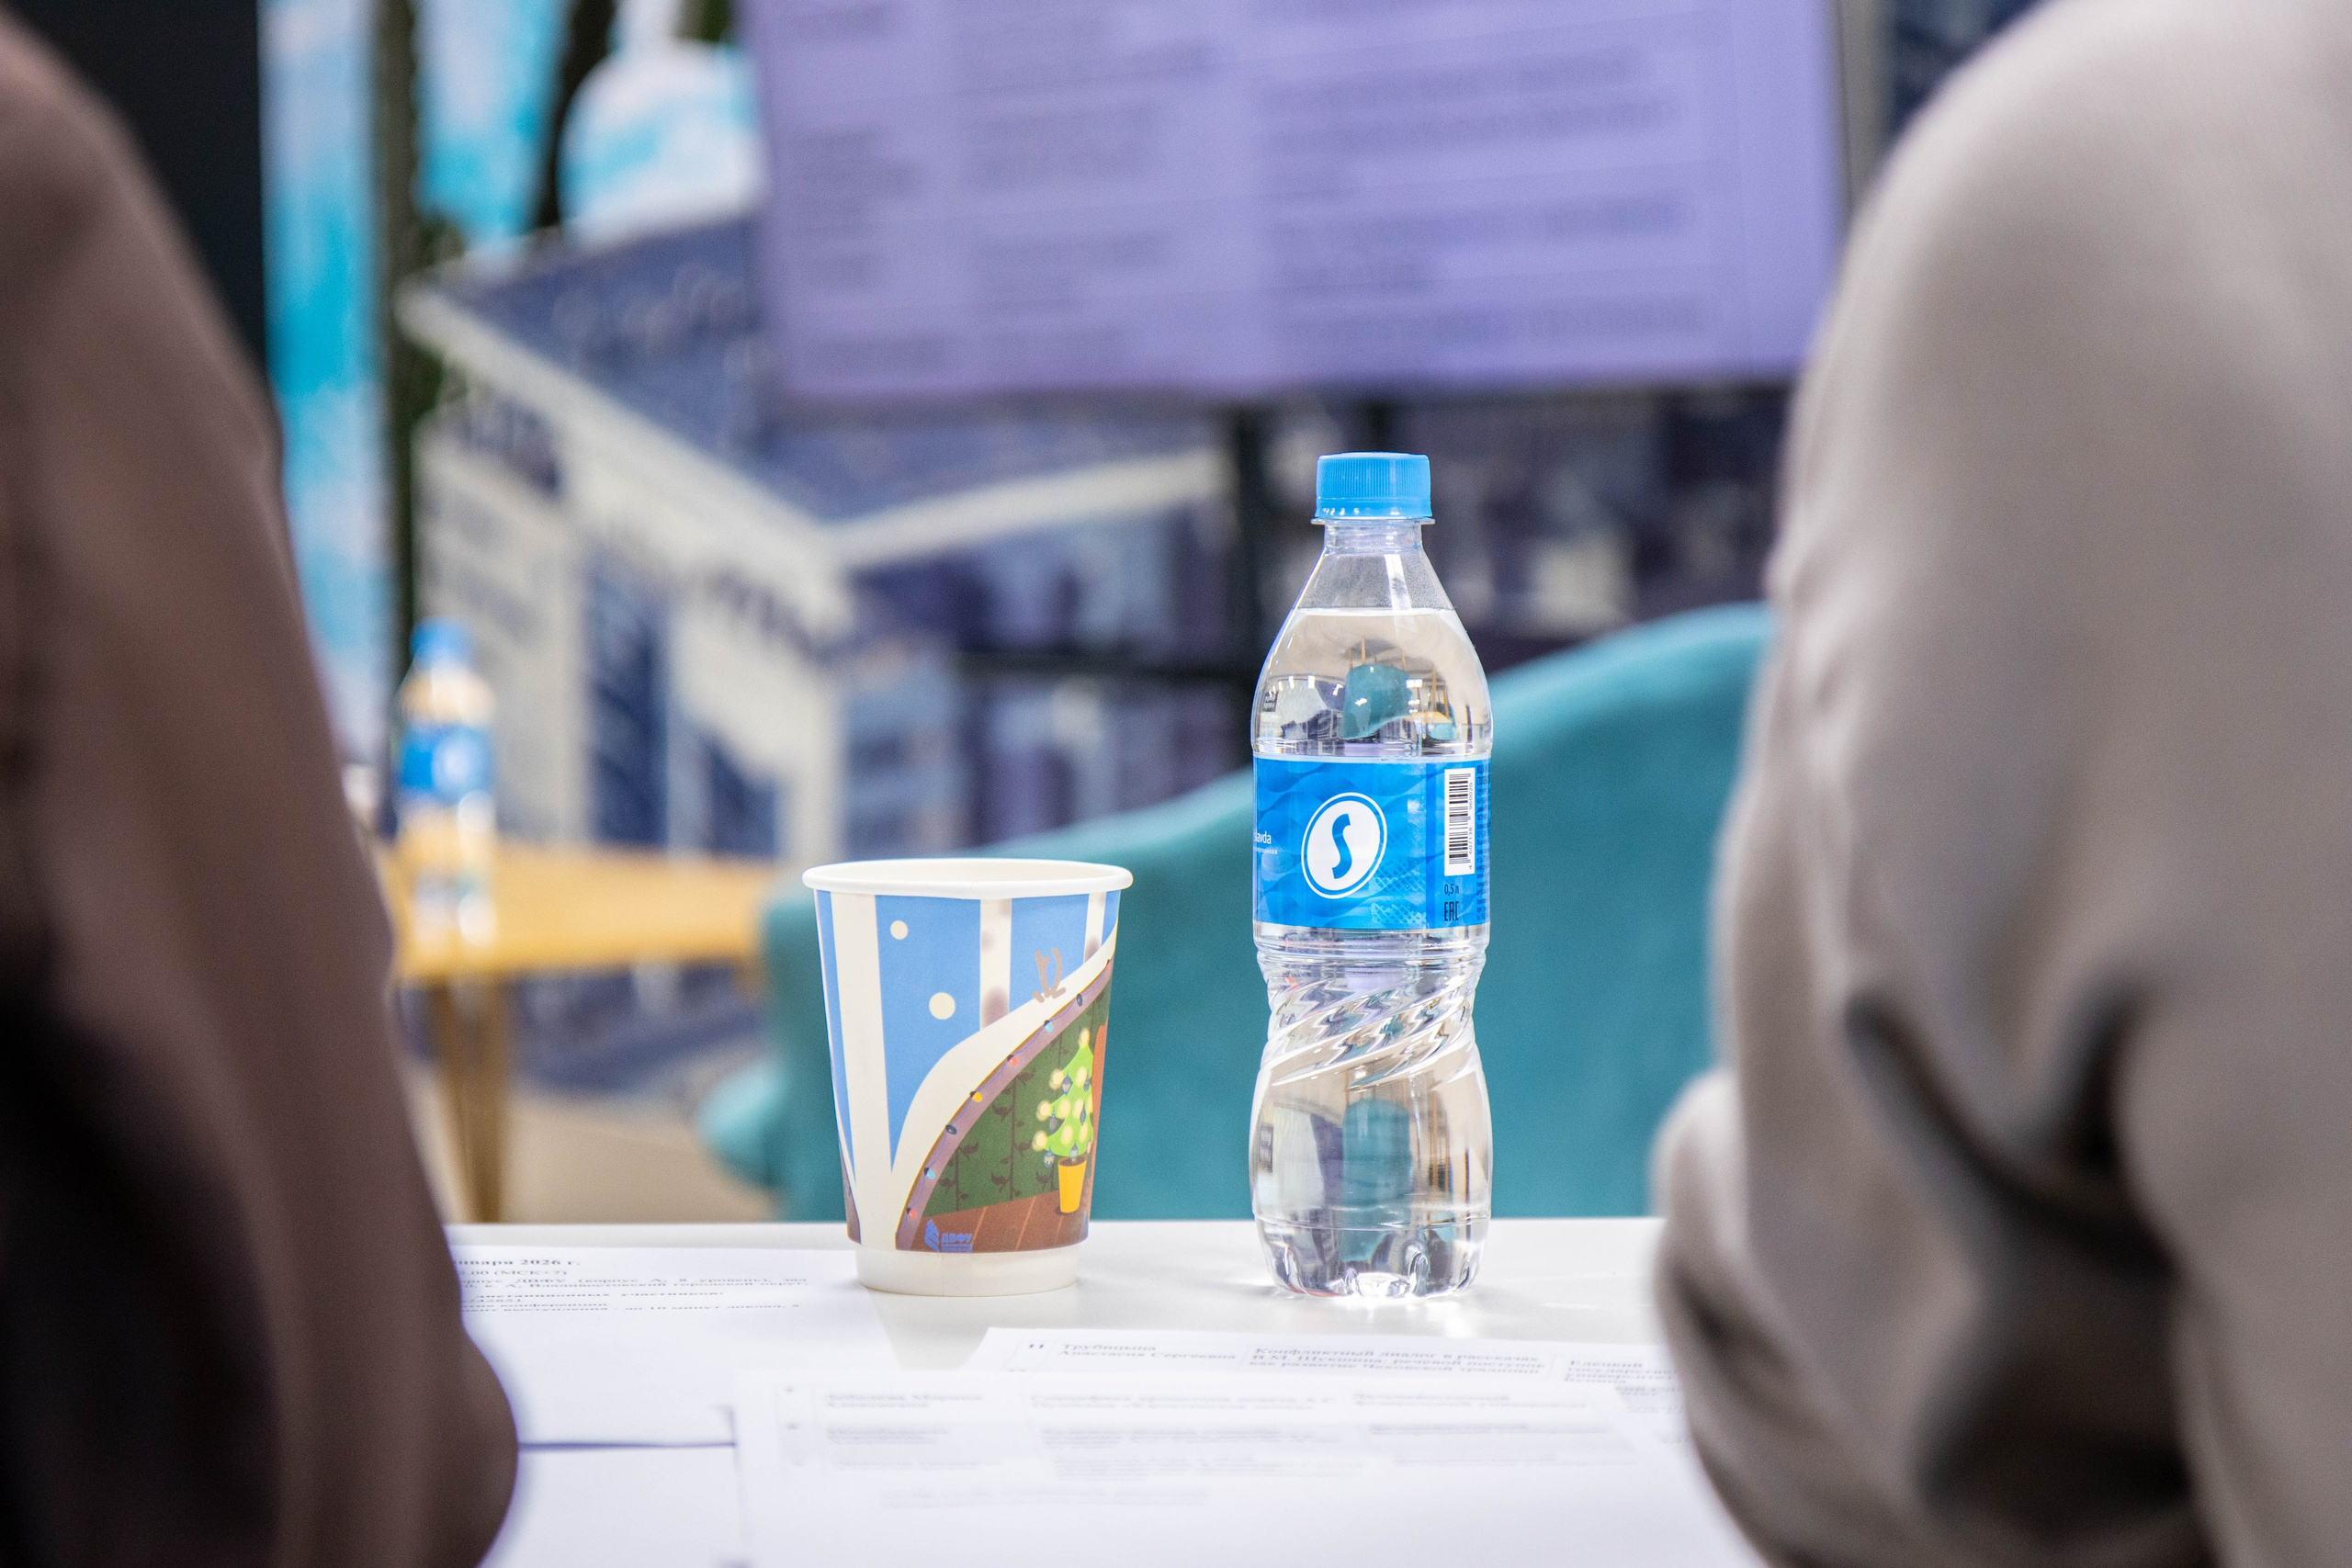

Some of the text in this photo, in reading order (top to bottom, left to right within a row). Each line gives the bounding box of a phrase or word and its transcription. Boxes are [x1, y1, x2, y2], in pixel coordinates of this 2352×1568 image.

[1443, 883, 1454, 896] 0,5
[941, 1233, 973, 1243] ДВФУ
[1255, 1348, 1374, 1357] Конфликтный
